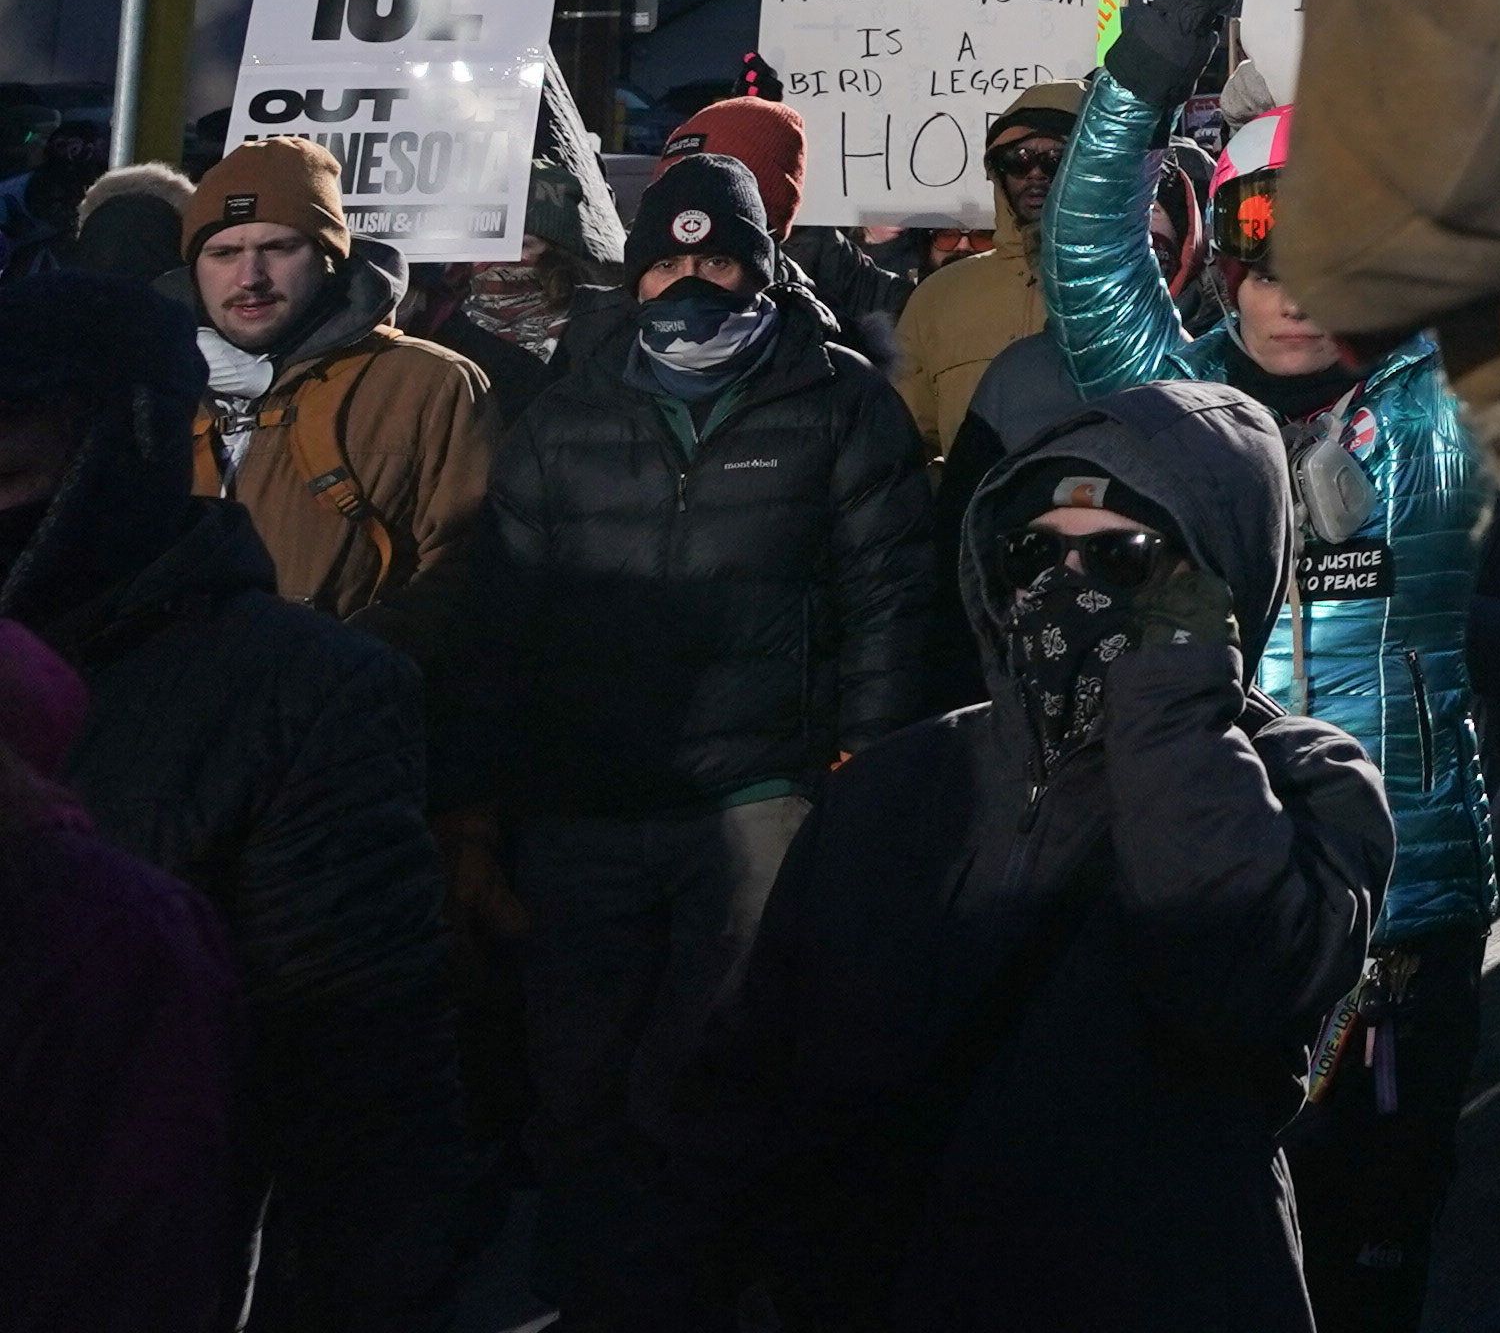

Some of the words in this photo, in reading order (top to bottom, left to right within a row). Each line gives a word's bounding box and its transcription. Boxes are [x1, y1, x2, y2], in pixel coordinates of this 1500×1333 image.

[857, 28, 904, 59] IS
[957, 31, 977, 62] A
[788, 69, 883, 97] BIRD
[931, 63, 1055, 97] LEGGED
[248, 88, 410, 124] OUT
[243, 130, 510, 196] NESOTA
[393, 212, 414, 232] &
[1318, 549, 1382, 572] JUSTICE
[1323, 572, 1378, 591] PEACE
